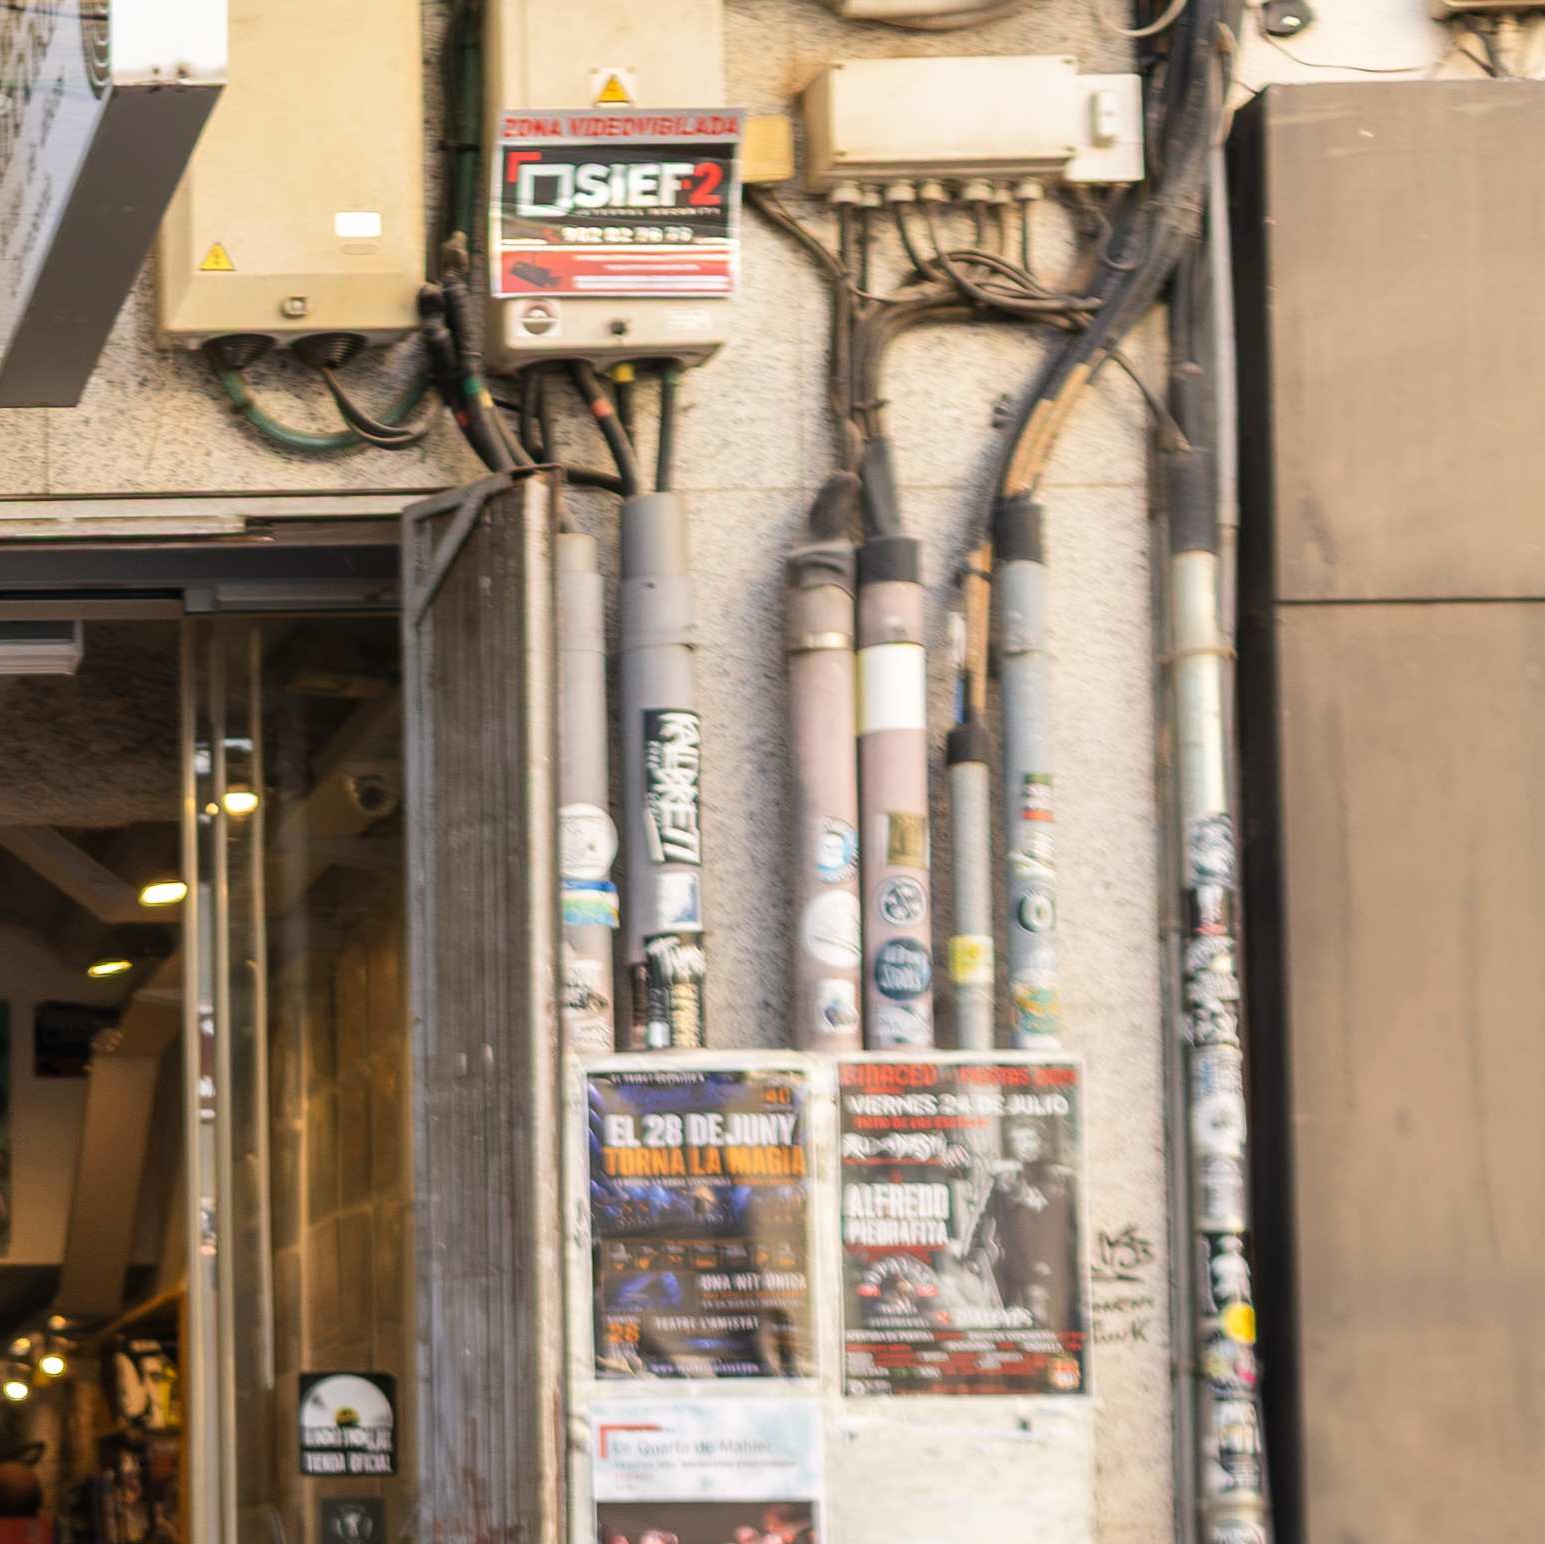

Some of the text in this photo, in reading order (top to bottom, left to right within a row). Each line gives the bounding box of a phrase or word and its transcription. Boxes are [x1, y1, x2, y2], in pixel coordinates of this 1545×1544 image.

[503, 115, 739, 138] ZONA VIDEOVIGILADA
[847, 1093, 940, 1116] VIERNES
[1006, 1093, 1069, 1116] JULIO
[605, 1111, 798, 1147] EL 28 DE JUNY
[603, 1146, 686, 1177] TORNA
[689, 1146, 724, 1176] LA
[844, 1183, 949, 1220] ALFREDO
[695, 1438, 713, 1455] de
